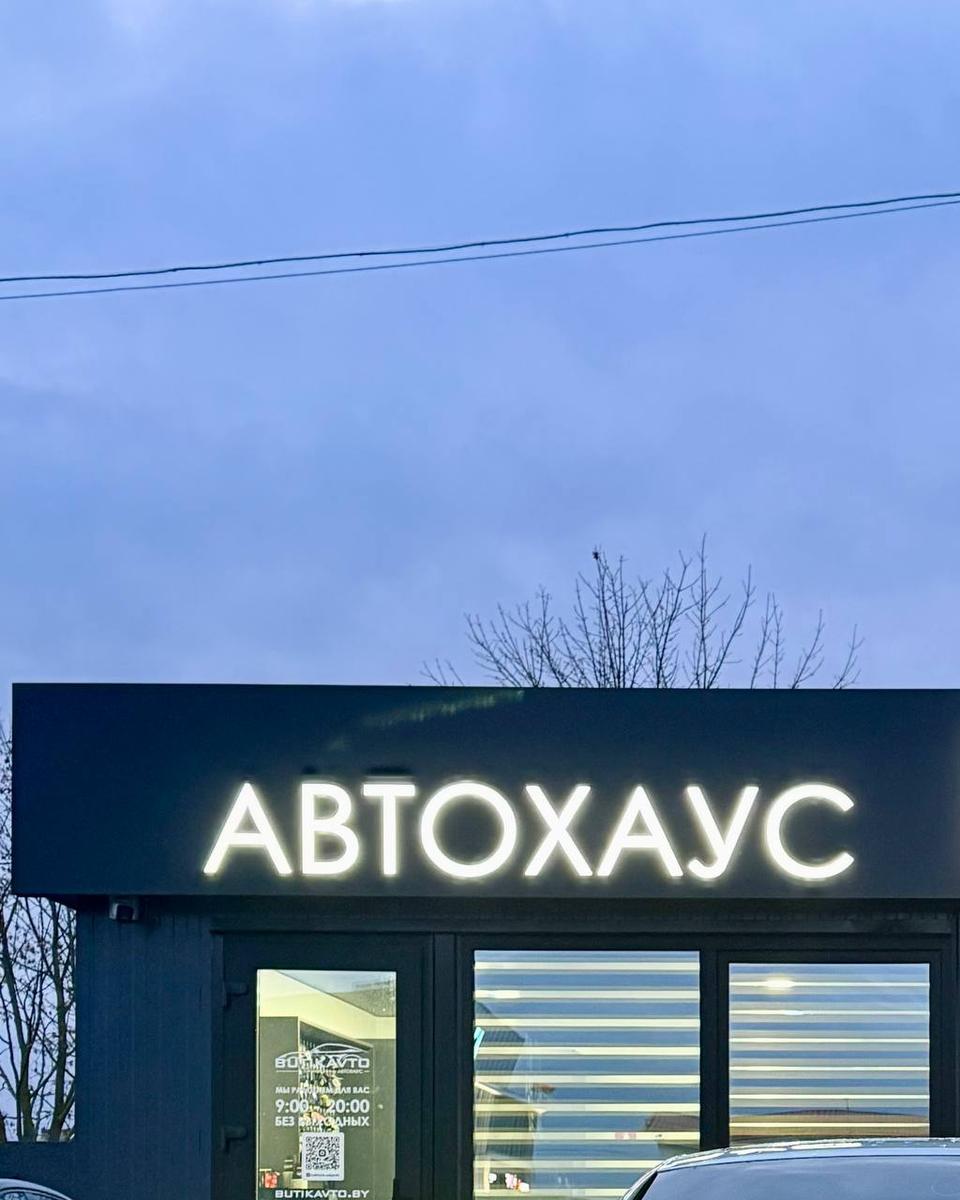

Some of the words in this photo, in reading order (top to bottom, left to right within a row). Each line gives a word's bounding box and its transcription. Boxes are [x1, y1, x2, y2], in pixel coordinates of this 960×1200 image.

[202, 782, 855, 881] АВТОХАУС
[275, 1098, 309, 1114] 9:00
[326, 1098, 370, 1114] 20:00
[275, 1116, 295, 1127] БЕЗ
[275, 1189, 370, 1198] BUTIKAVTO.BY
